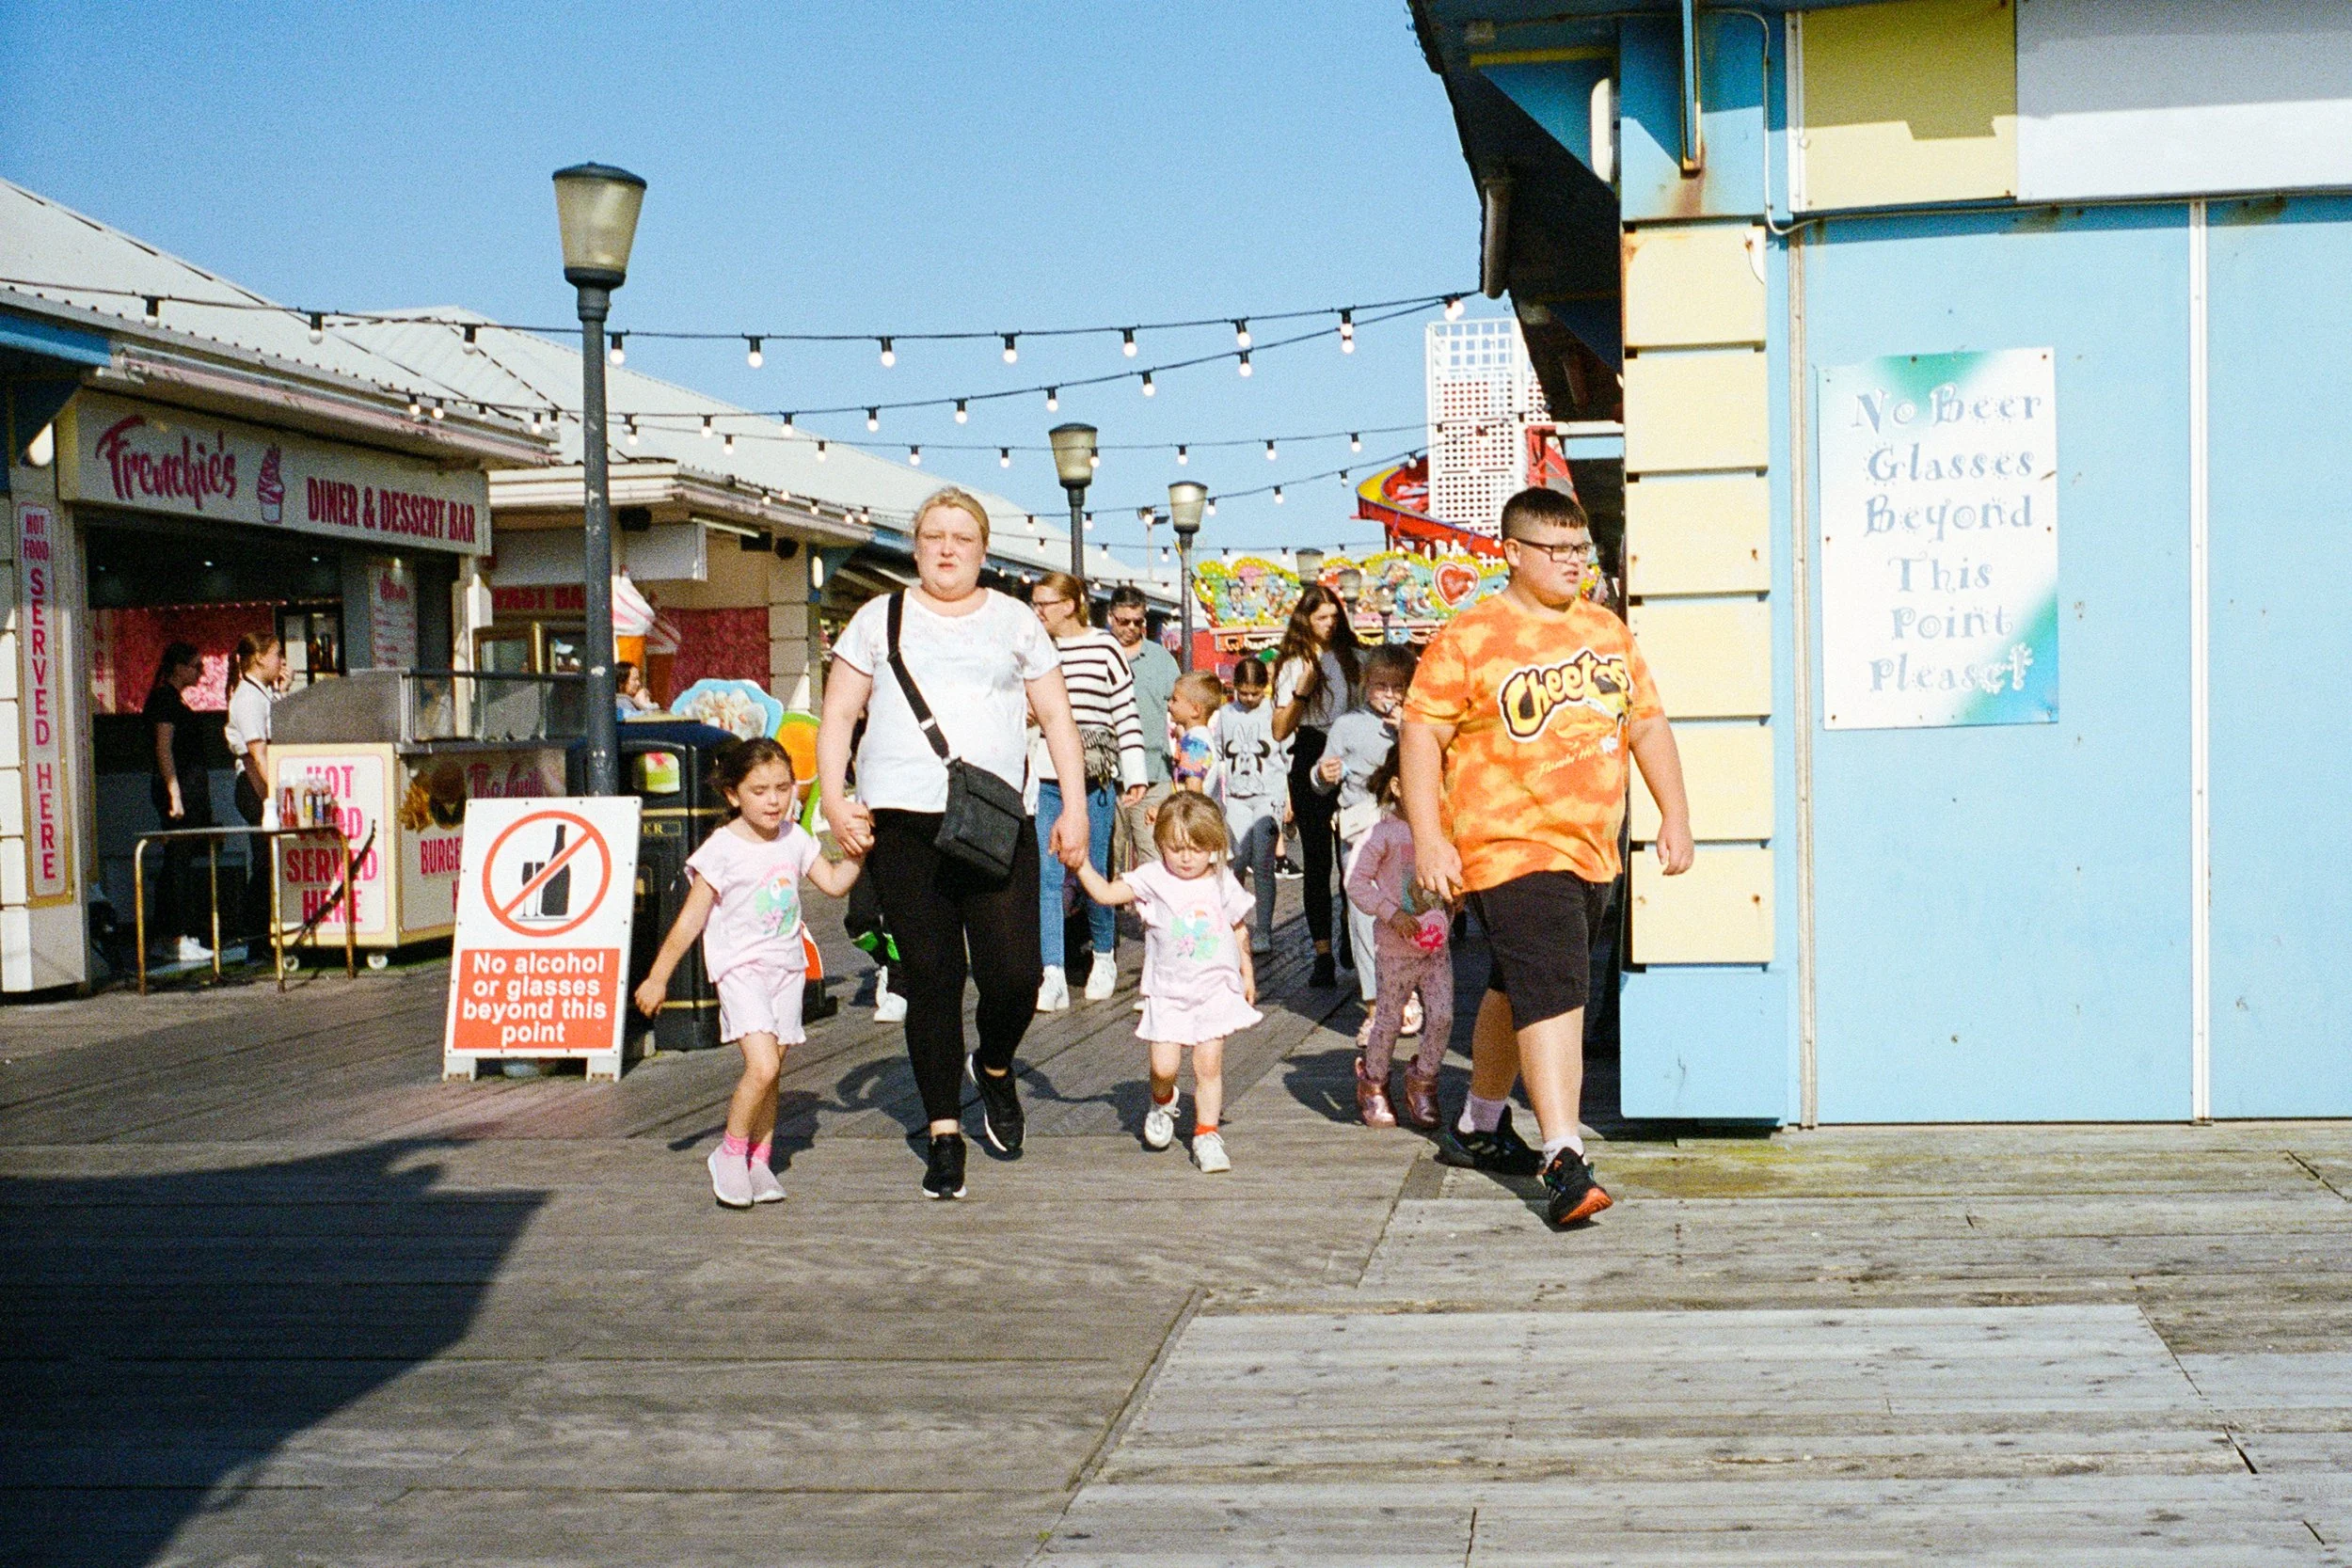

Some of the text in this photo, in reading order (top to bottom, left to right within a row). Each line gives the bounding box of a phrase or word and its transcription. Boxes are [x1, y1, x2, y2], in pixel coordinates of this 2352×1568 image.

[1851, 383, 2042, 434] No Beer
[95, 414, 237, 511] Frenchie's
[1865, 441, 2034, 486] Glasses
[25, 514, 45, 535] HOT
[307, 477, 476, 544] DINER & DESSERT BAR
[1865, 493, 2034, 543] Beyond
[23, 537, 49, 562] FOOD
[1888, 550, 1994, 594] This
[553, 584, 586, 610] BA
[1890, 606, 2013, 641] Point
[1500, 649, 1631, 737] Cheetos
[29, 566, 56, 880] SERVED HERE
[307, 765, 355, 799] OT
[420, 835, 464, 876] BURGE
[473, 950, 605, 974] No alcohol
[473, 974, 601, 1002] or glasses
[463, 997, 607, 1024] beyond this
[501, 1021, 565, 1048] point
